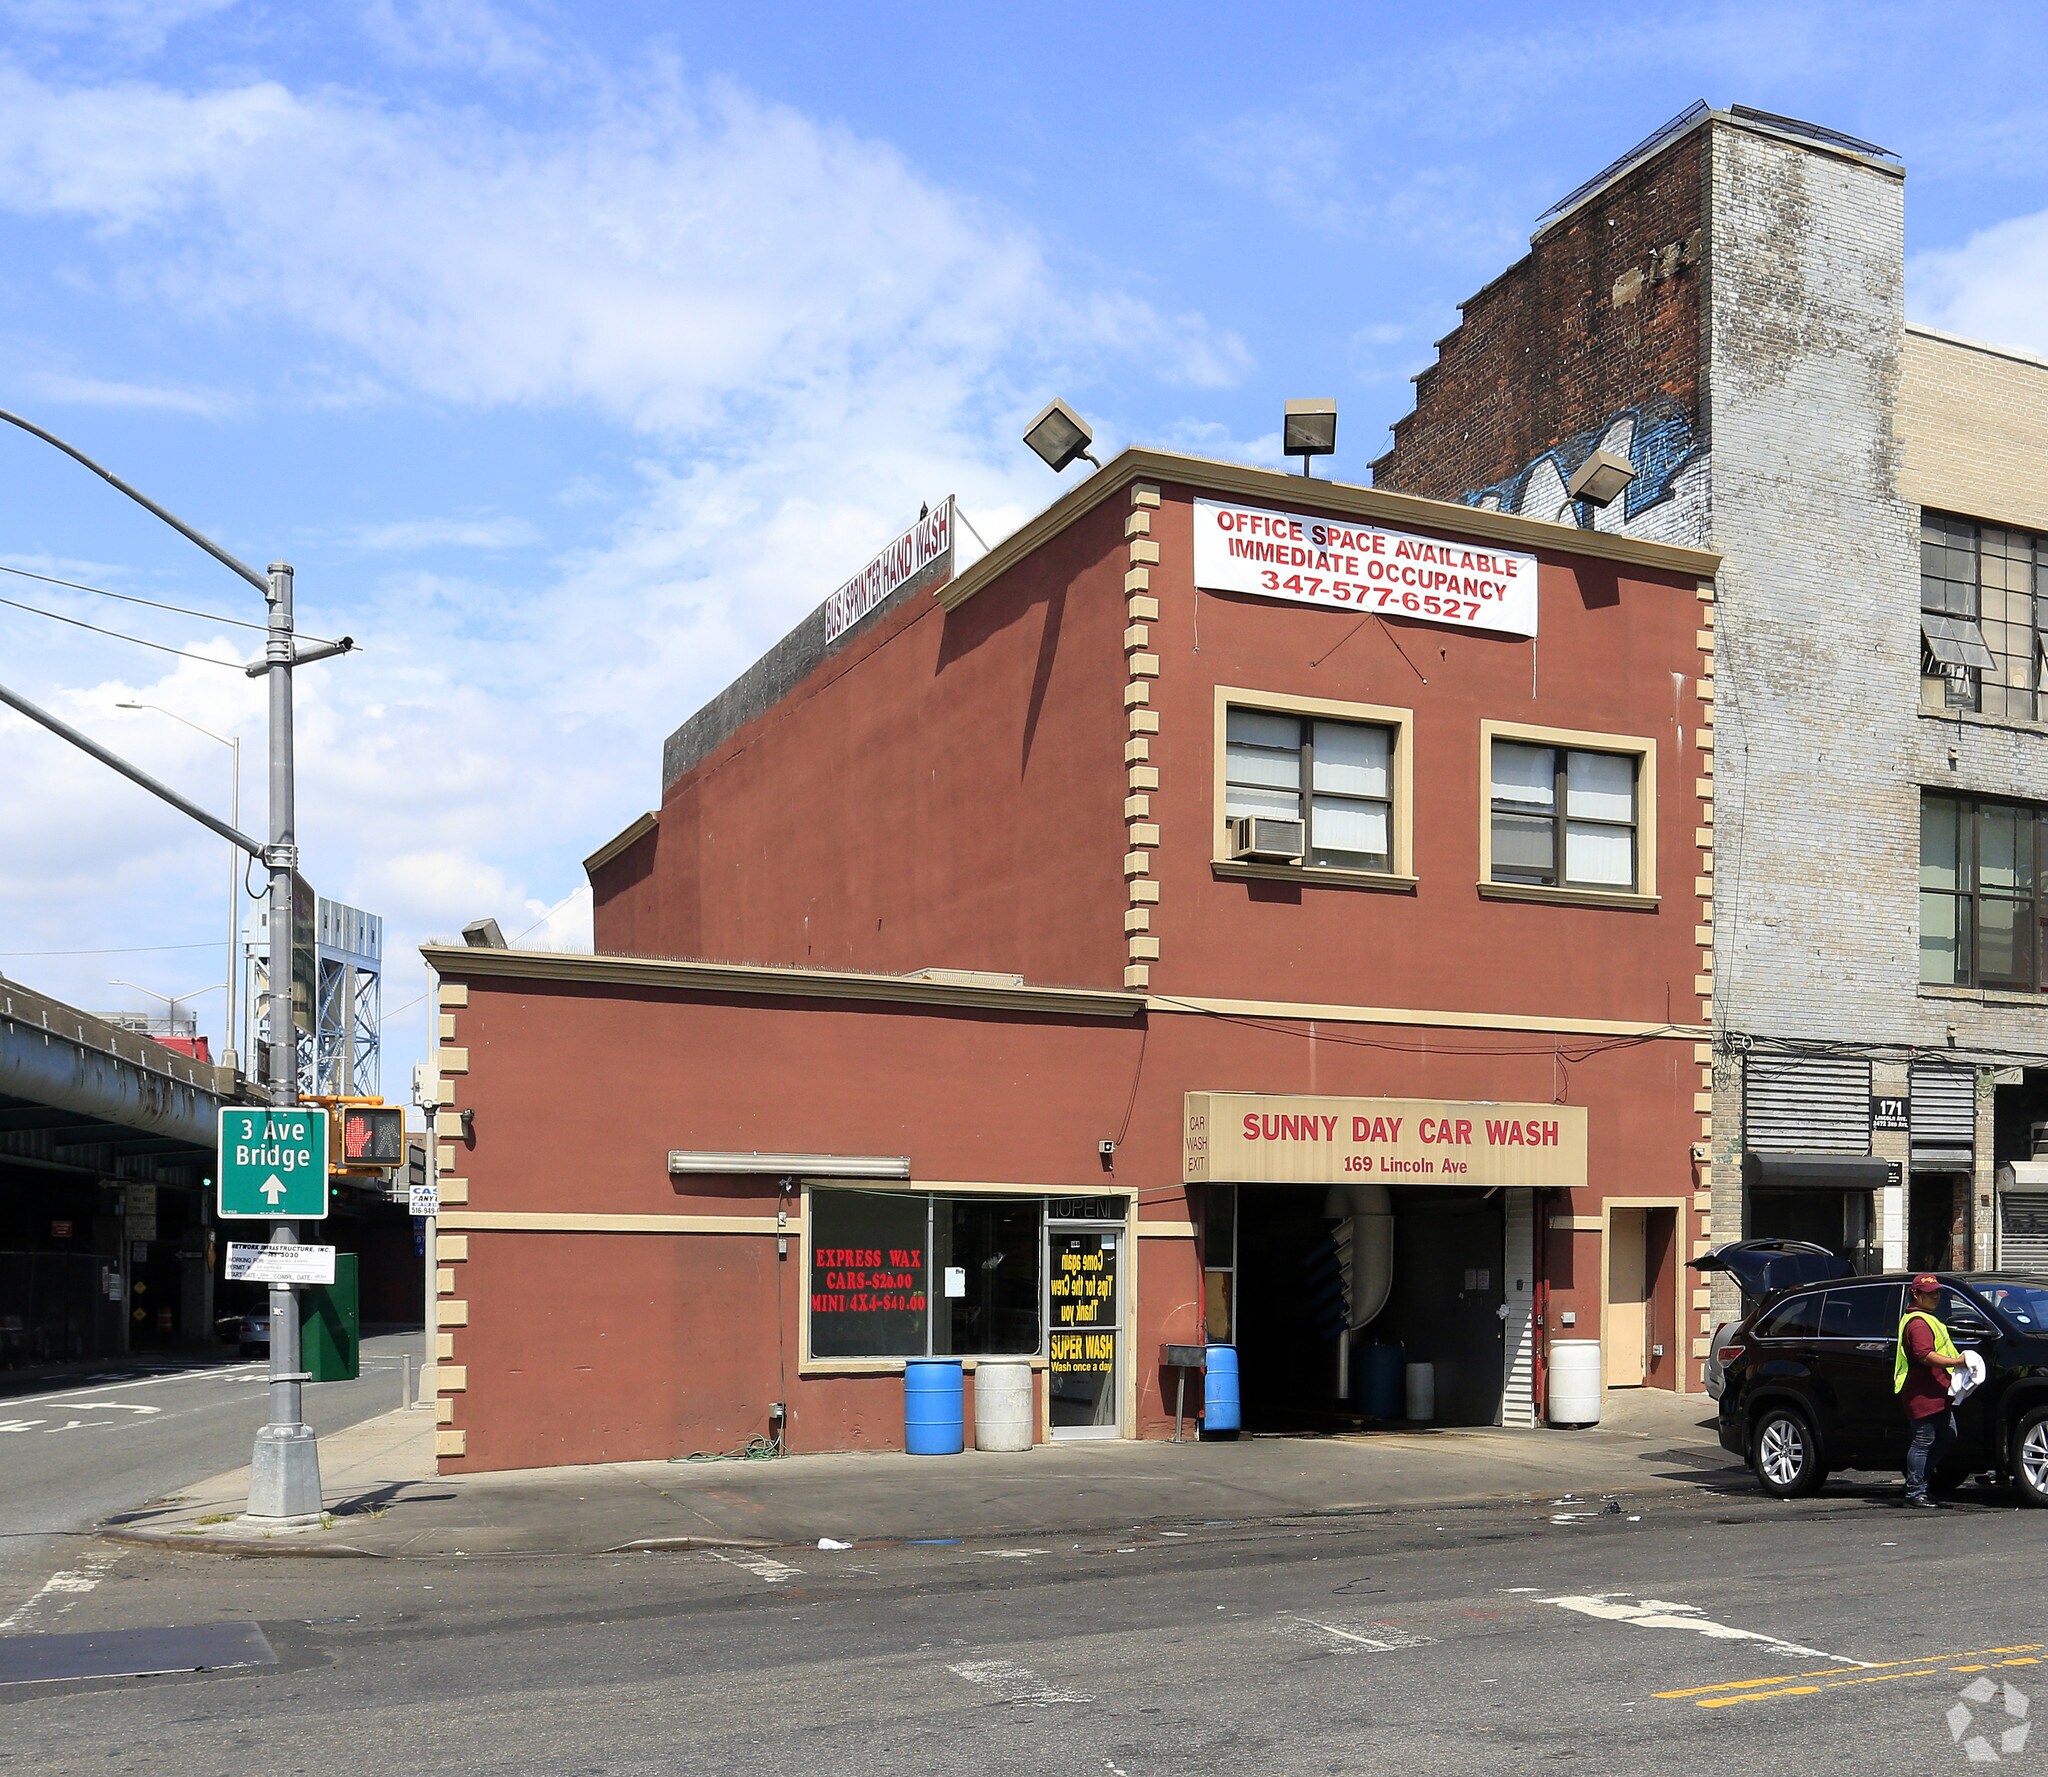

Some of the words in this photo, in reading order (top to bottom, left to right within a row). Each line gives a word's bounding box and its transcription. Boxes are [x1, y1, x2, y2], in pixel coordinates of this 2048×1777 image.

[883, 534, 913, 595] HAND
[915, 503, 948, 568] WASH
[1217, 510, 1303, 542] OFFICE
[1311, 525, 1386, 555] SPACE
[1395, 538, 1518, 578] AVAILABLE
[1228, 538, 1359, 577] IMMEDIATE
[1367, 560, 1508, 602] OCCUPANCY
[1260, 569, 1482, 622] 347-577-6527
[1880, 1100, 1902, 1115] 171
[241, 1119, 253, 1141] 3
[263, 1119, 304, 1141] Ave
[1189, 1115, 1205, 1132] CAR
[1242, 1113, 1338, 1142] SUNNY
[1352, 1116, 1403, 1143] DAY
[1418, 1118, 1472, 1145] CAR
[1485, 1119, 1559, 1146] WASH
[1186, 1135, 1208, 1152] WASH
[236, 1143, 310, 1172] Bridge
[1188, 1156, 1205, 1172] EXIT
[1344, 1156, 1373, 1173] 169
[1380, 1157, 1434, 1174] Lincoln
[1442, 1158, 1468, 1175] Ave
[816, 1249, 882, 1268] EXPRESS
[889, 1249, 921, 1268] WAX
[1051, 1334, 1083, 1360] SUPER
[1085, 1334, 1113, 1360] WASH
[1051, 1361, 1072, 1372] Wash
[1073, 1362, 1091, 1372] once
[1092, 1363, 1098, 1371] a
[1099, 1361, 1112, 1373] day
